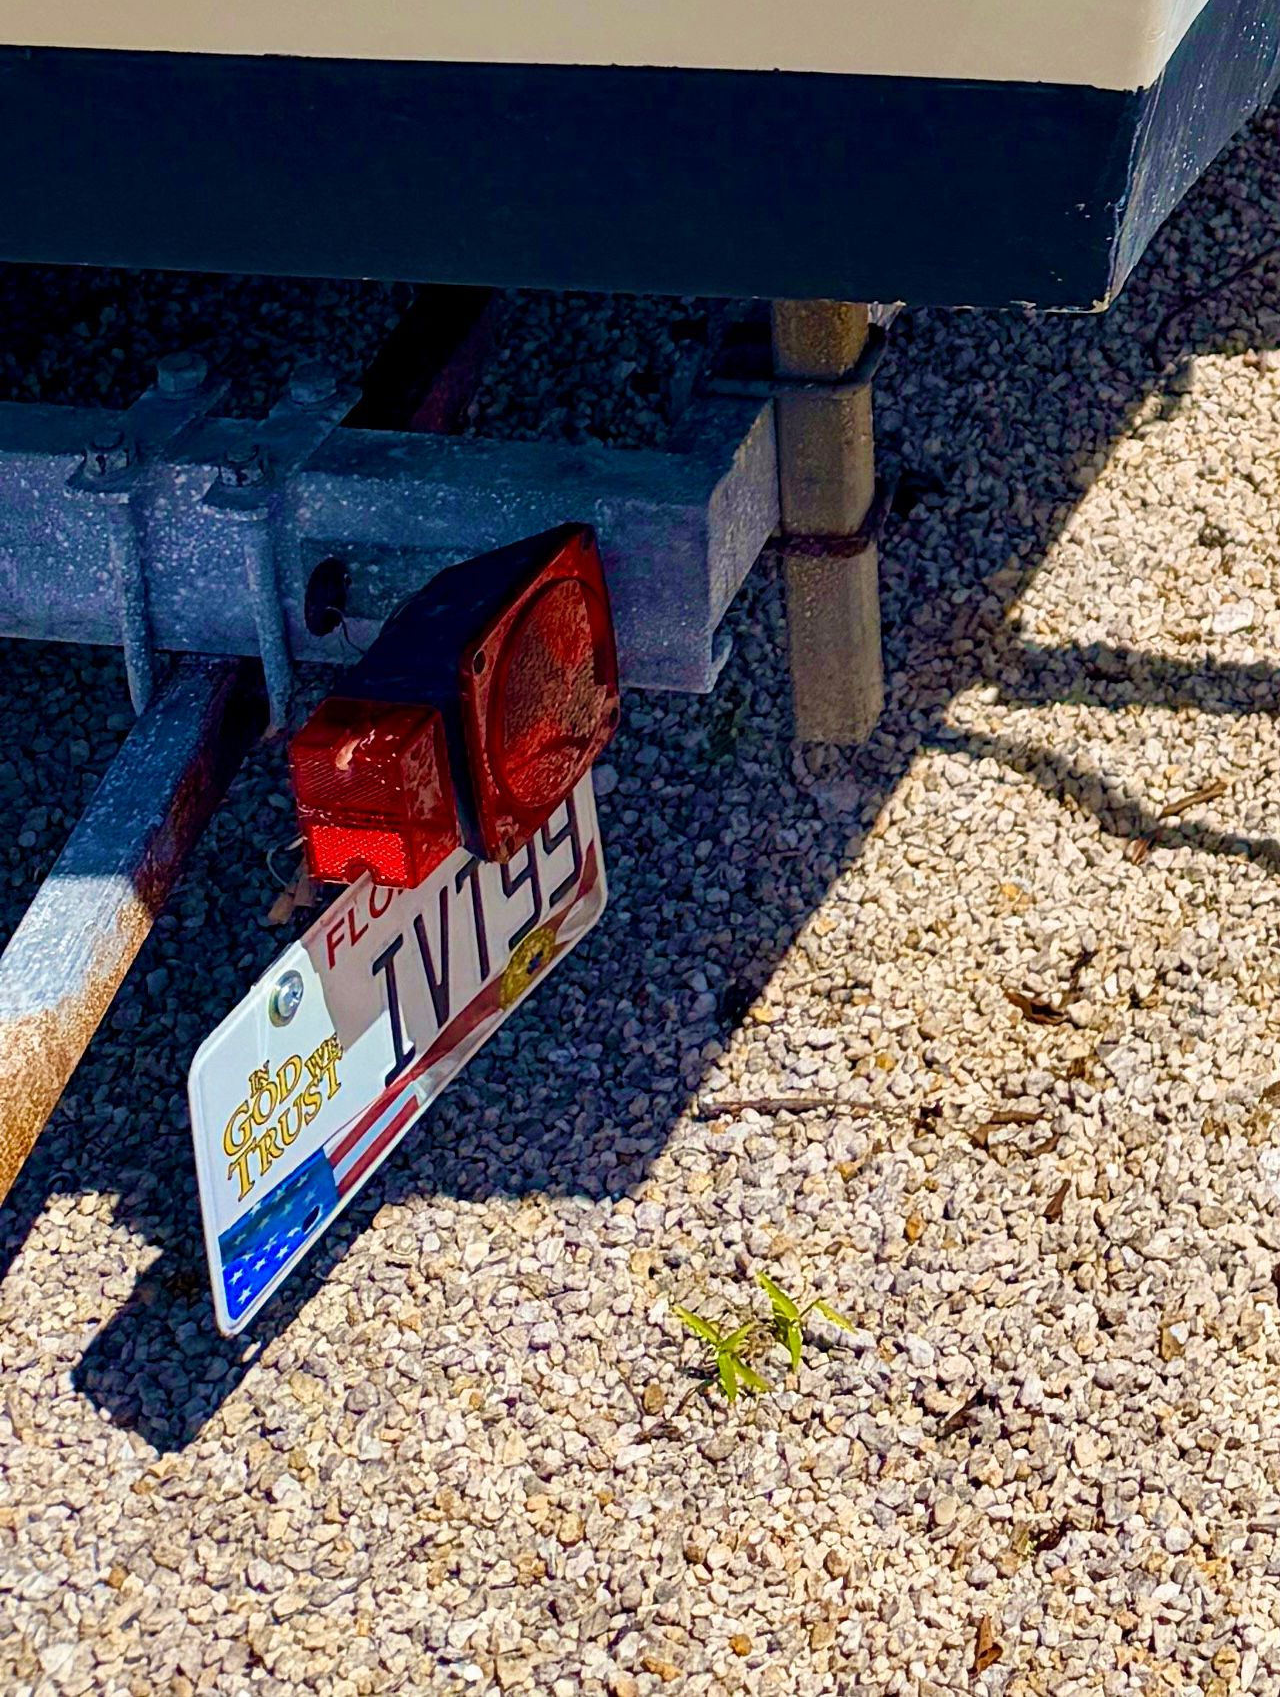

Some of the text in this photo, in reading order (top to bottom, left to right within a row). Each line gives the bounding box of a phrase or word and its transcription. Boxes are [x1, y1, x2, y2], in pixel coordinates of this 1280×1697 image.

[223, 1032, 344, 1157] GOD WE
[227, 1054, 342, 1202] TRUST
[248, 1060, 270, 1099] IN
